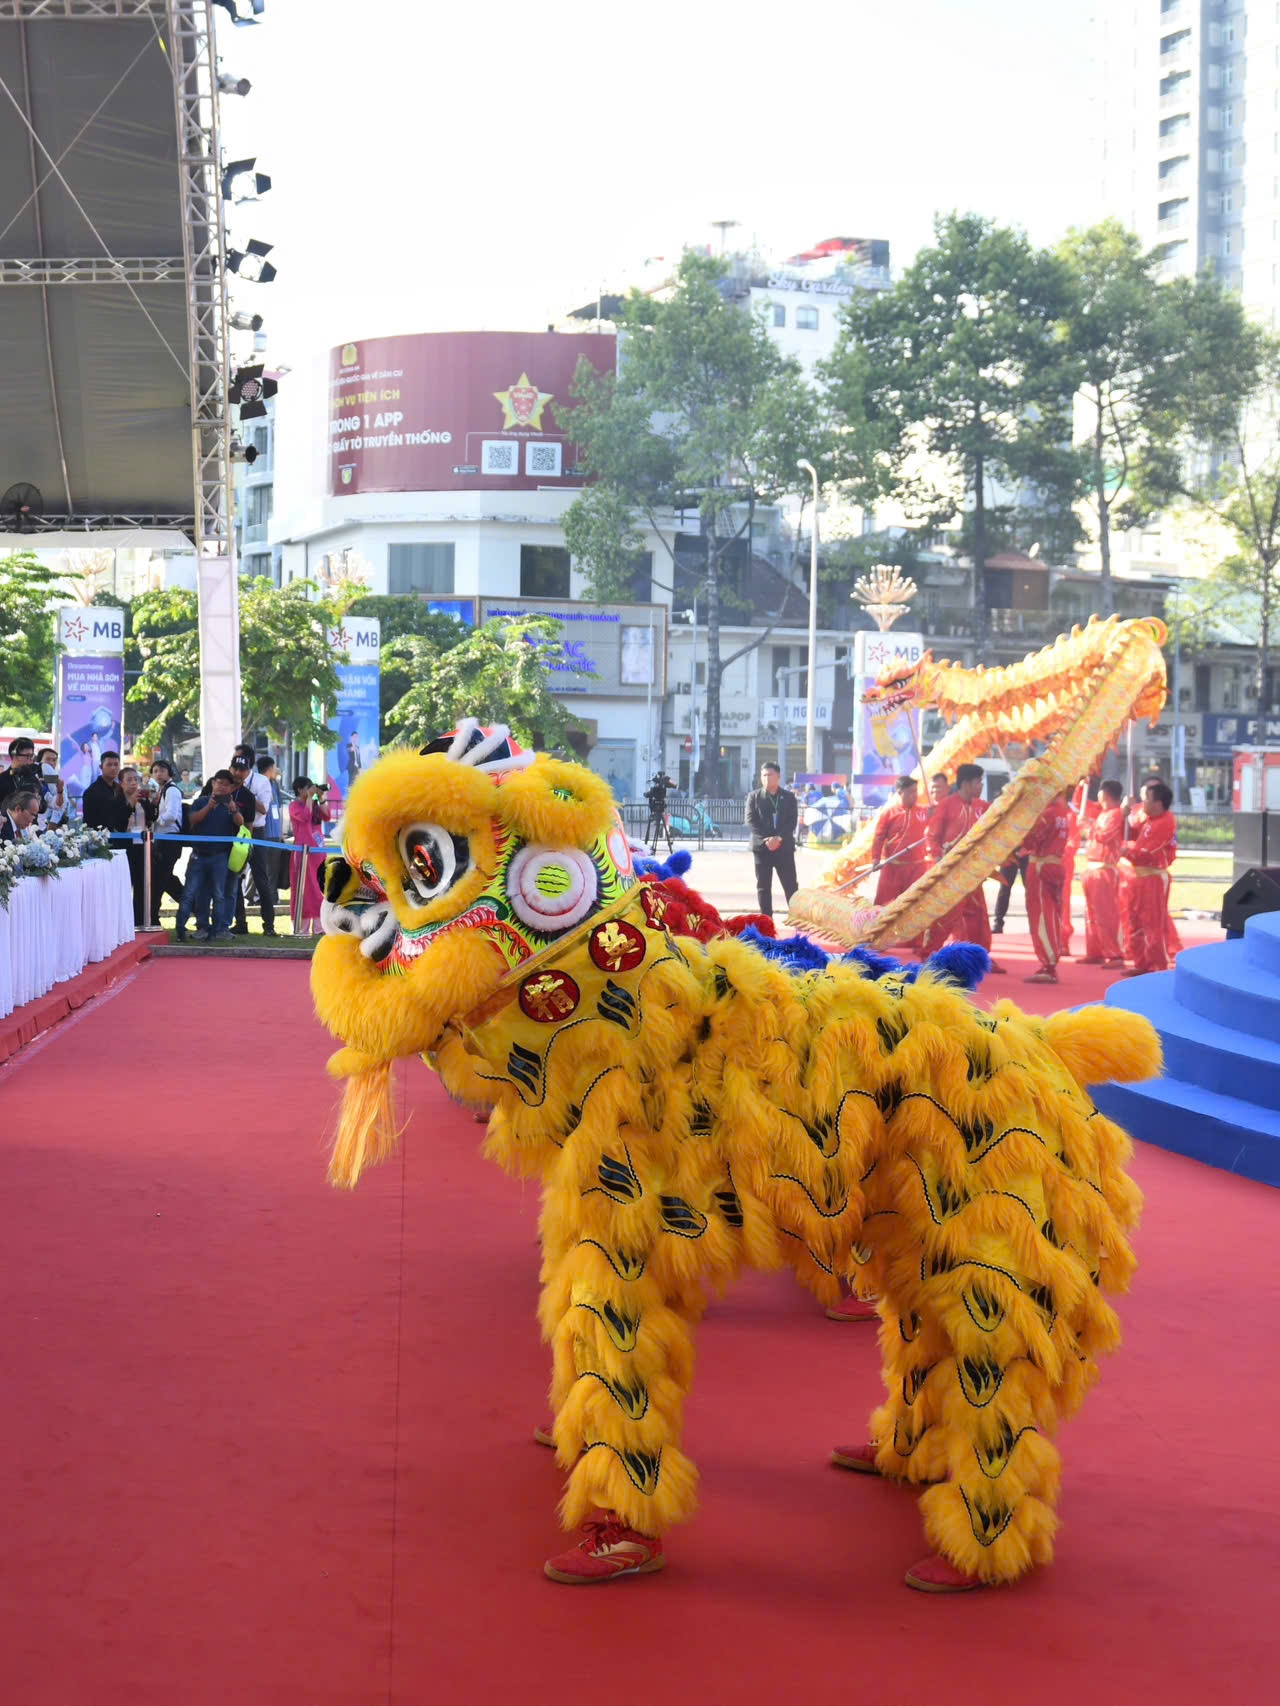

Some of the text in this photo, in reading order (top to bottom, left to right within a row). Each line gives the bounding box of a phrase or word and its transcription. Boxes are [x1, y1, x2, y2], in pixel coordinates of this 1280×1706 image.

[380, 388, 400, 401] ÍCH
[364, 414, 369, 429] 1
[374, 411, 404, 428] APP
[405, 429, 452, 444] THỐNG
[93, 621, 122, 638] MB
[356, 631, 378, 647] MB
[894, 645, 920, 661] MB
[67, 673, 85, 681] MUA
